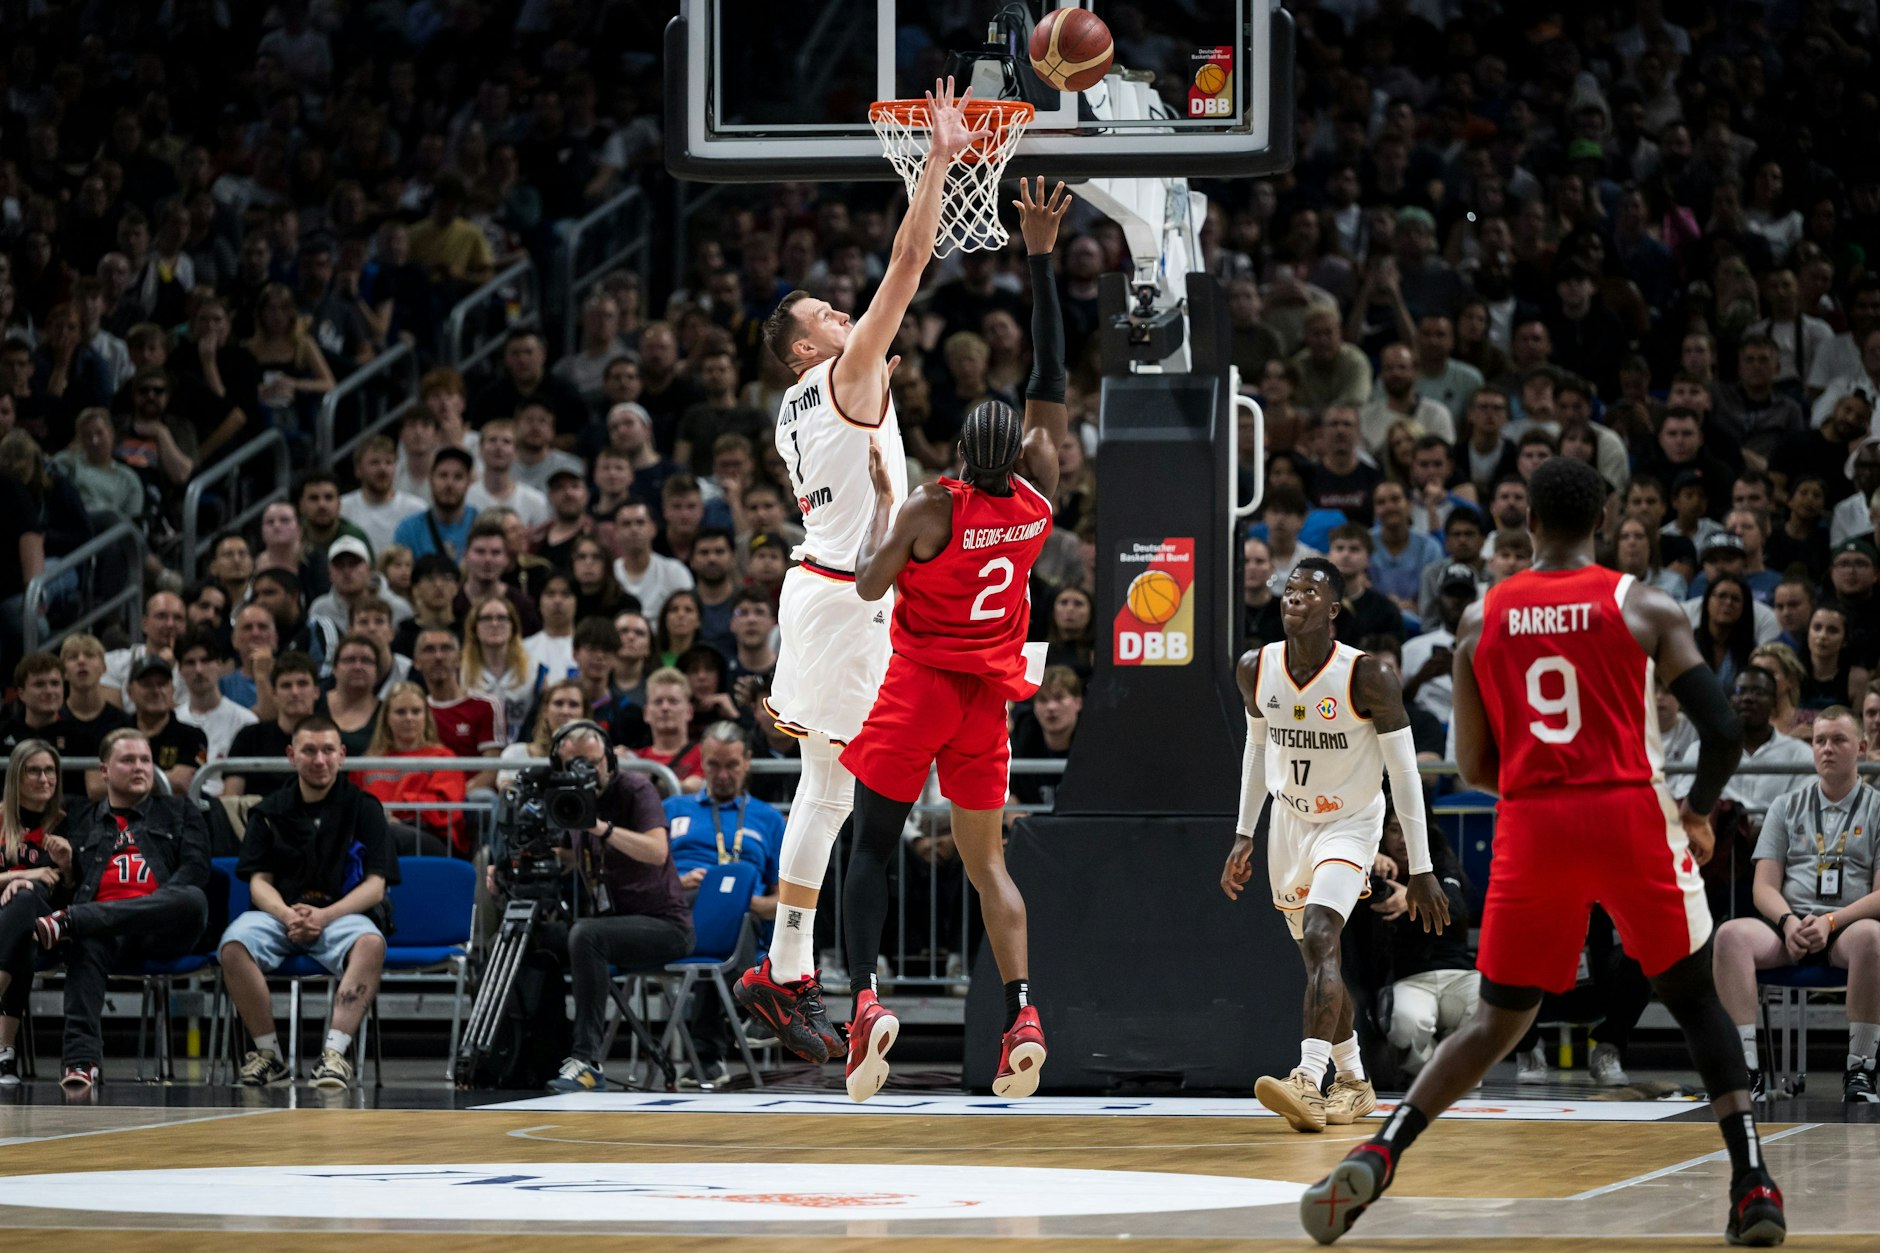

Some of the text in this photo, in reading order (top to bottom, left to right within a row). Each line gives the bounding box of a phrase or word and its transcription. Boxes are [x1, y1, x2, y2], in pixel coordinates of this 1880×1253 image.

[1191, 98, 1230, 114] DBB
[962, 517, 1047, 549] GILGEOUS-ALEXANDER
[1133, 543, 1176, 552] Deutscher
[1120, 553, 1189, 562] Basketball Bund
[969, 556, 1014, 620] 2
[1508, 603, 1592, 636] BARRETT
[1119, 631, 1188, 660] DBB
[1525, 655, 1582, 743] 9
[1269, 727, 1349, 749] EUTSCHLAND
[1291, 759, 1311, 786] 17
[112, 853, 151, 884] 17
